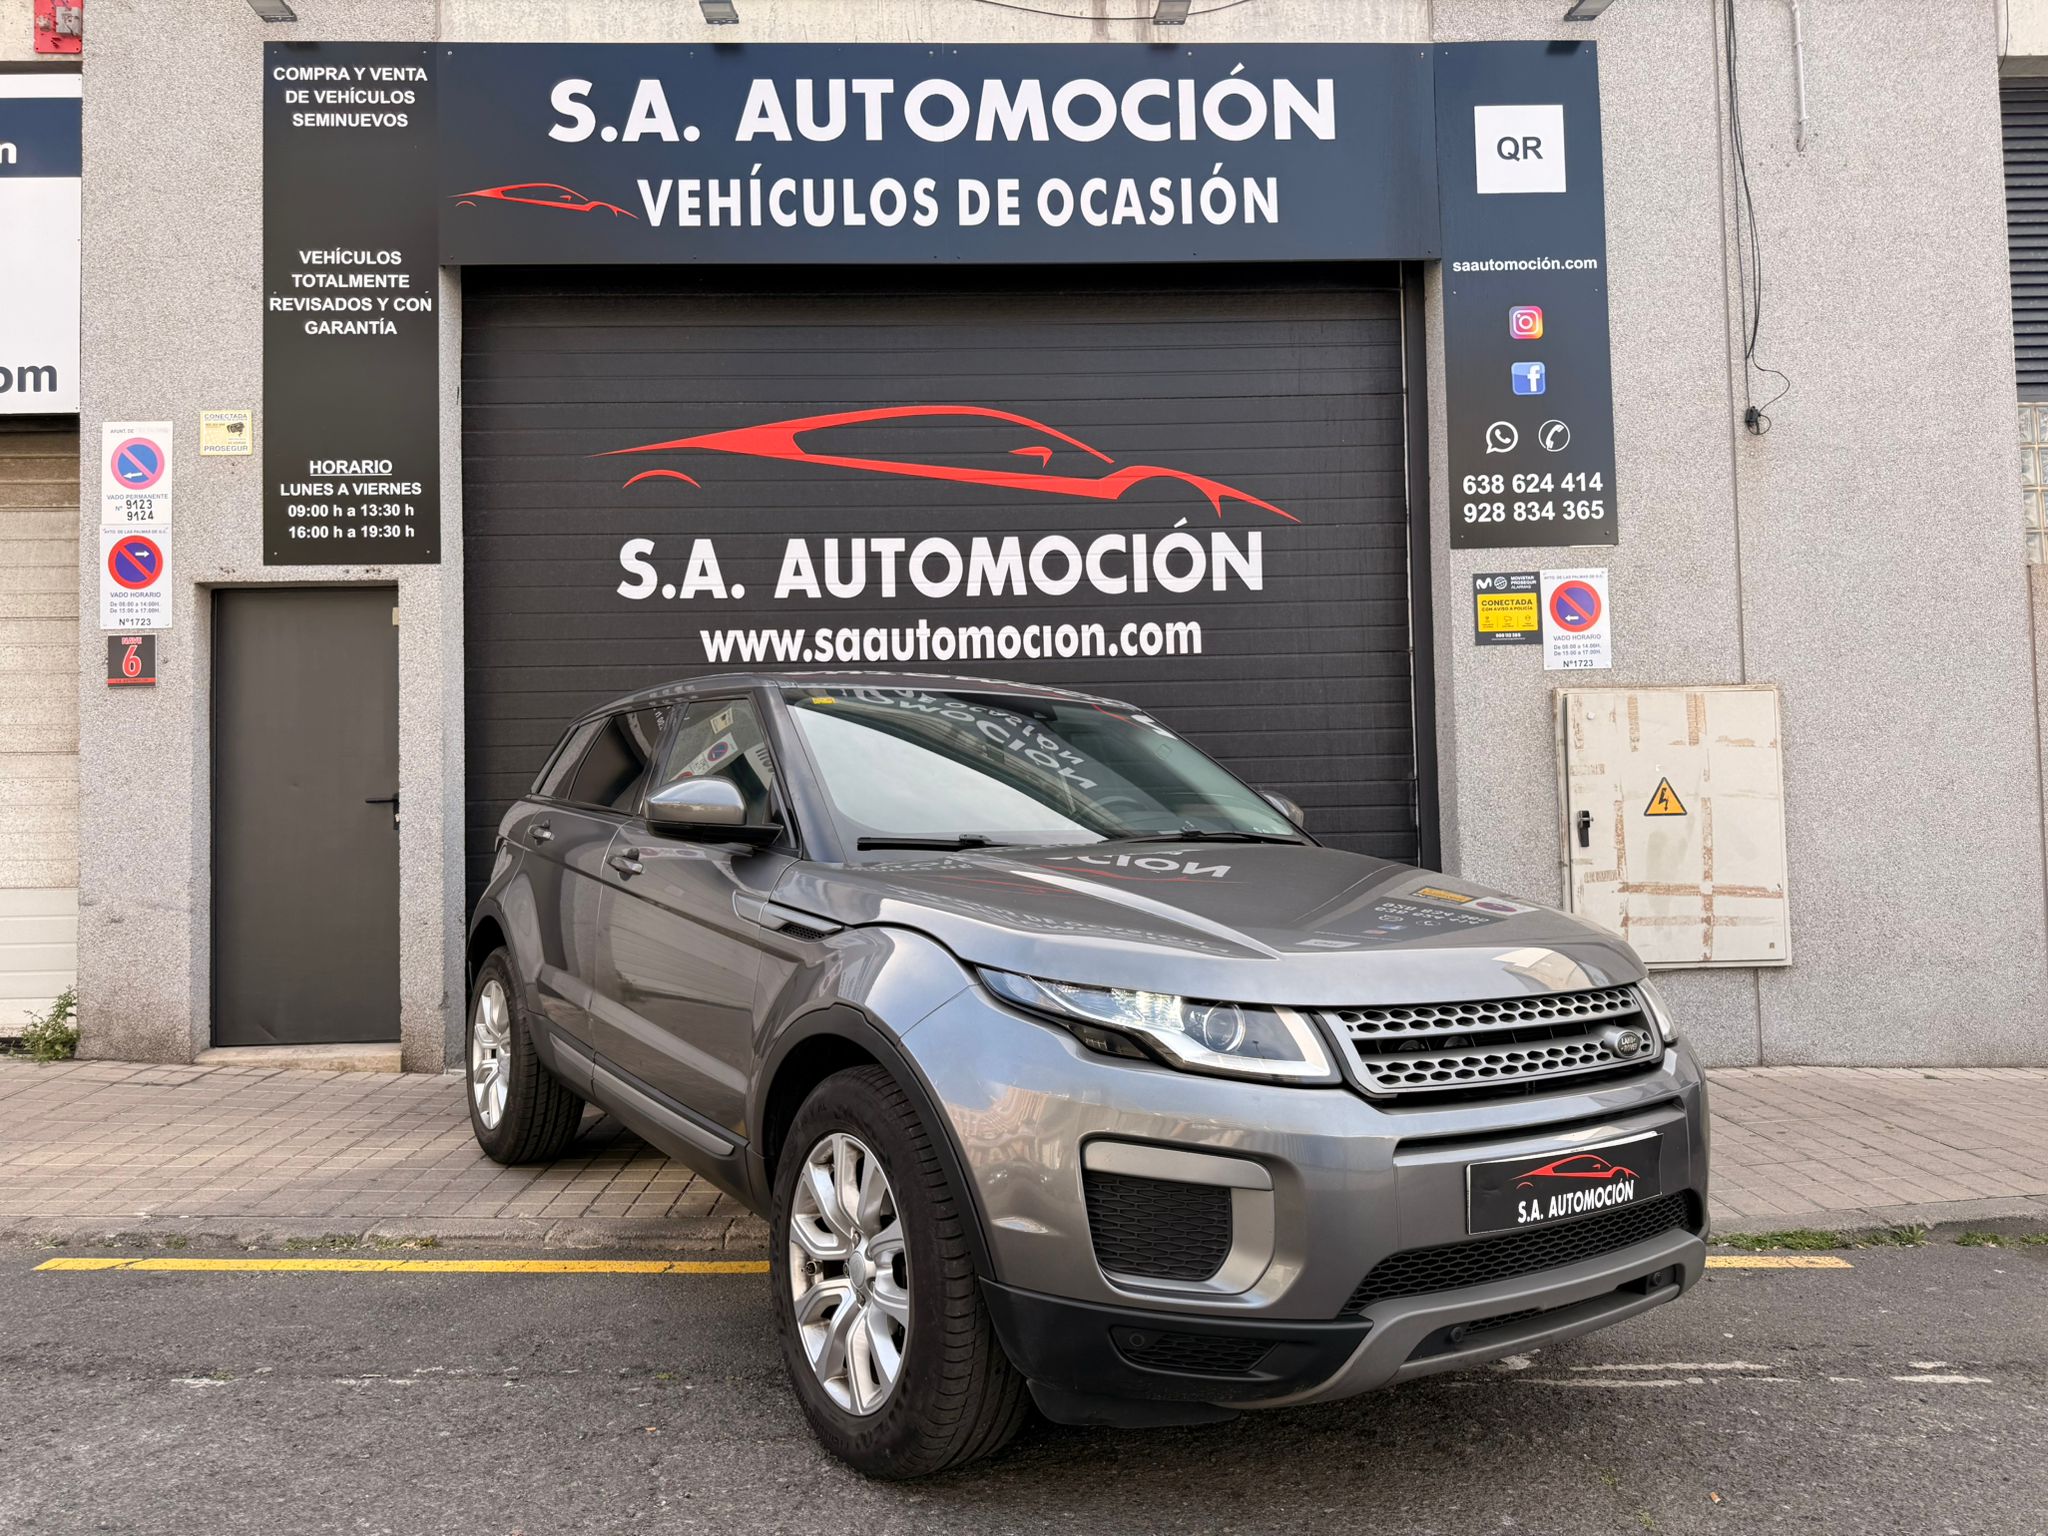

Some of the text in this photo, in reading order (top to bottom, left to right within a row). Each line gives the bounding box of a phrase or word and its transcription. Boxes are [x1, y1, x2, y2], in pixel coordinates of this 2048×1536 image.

[273, 66, 428, 82] COMPRA Y VENTA
[285, 86, 416, 105] DE VEHÍCULOS
[548, 62, 1336, 143] S.A. AUTOMOCIÓN
[292, 112, 409, 128] SEMINUEVOS
[1497, 136, 1543, 162] QR
[636, 162, 1279, 228] VEHÍCULOS DE OCASIÓN
[298, 247, 402, 265] VEHÍCULOS
[1452, 256, 1598, 272] saautomoción.com
[291, 273, 410, 288] TOTALMENTE
[269, 296, 432, 312] REVISADOS Y CON
[304, 317, 398, 335] GARANTÍA
[309, 459, 393, 474] HORARIO
[280, 481, 422, 497] LUNES A VIERNES
[1462, 471, 1604, 496] 638 624 414
[126, 500, 153, 510] 9123
[287, 503, 415, 518] 09:00 h a 13:30 h
[1463, 499, 1605, 524] 928 834 365
[127, 511, 154, 521] 9124
[288, 524, 415, 539] 16:00 h a 19:30 h
[616, 516, 1263, 600] S.A. AUTOMOCIÓN
[118, 618, 152, 626] Nº1723
[699, 618, 1202, 663] www.saautomocion.com
[122, 644, 142, 677] 6
[1563, 660, 1594, 668] Nº1723
[1517, 1178, 1635, 1224] S.A. AUTOMOCIÓN
